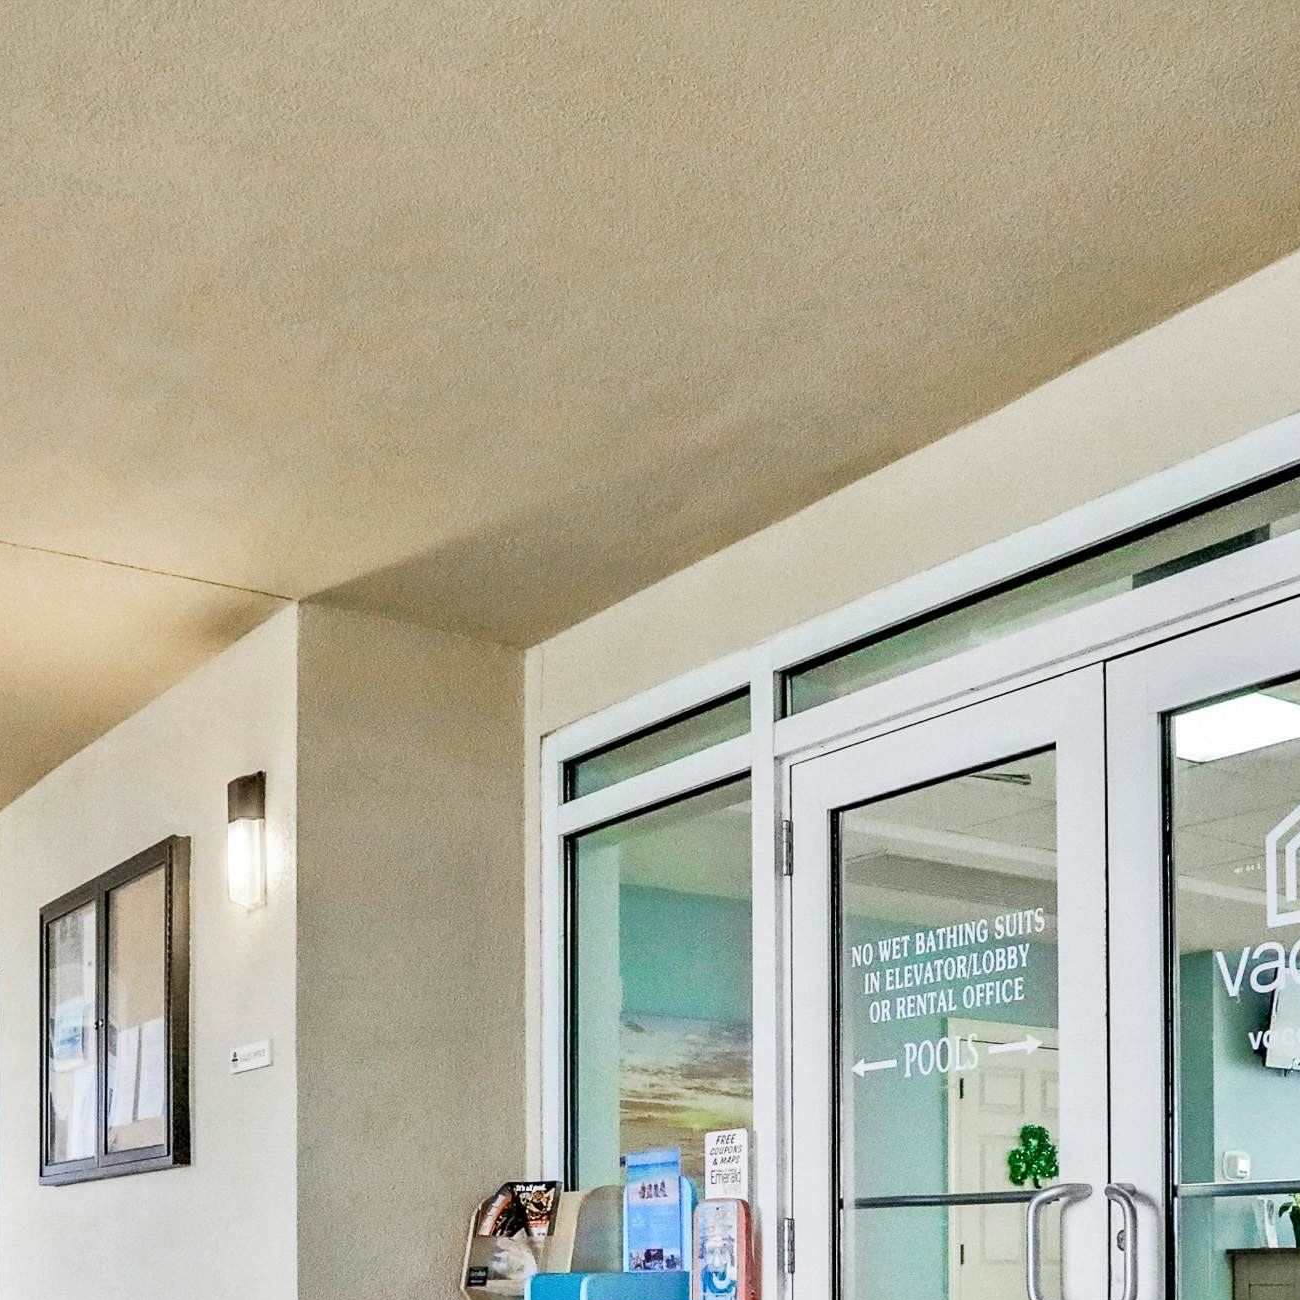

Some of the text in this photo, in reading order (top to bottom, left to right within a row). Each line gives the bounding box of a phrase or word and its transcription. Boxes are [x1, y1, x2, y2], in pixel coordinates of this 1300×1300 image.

[851, 907, 1045, 968] NO WET BATHING SUITS
[864, 943, 1030, 994] IN ELEVATOR/LOBBY
[869, 976, 1025, 1024] OR RENTAL OFFICE
[904, 1033, 979, 1078] POOLS
[709, 1144, 743, 1156] COUPONS
[715, 1133, 737, 1146] FREE
[720, 1155, 741, 1165] MAPS
